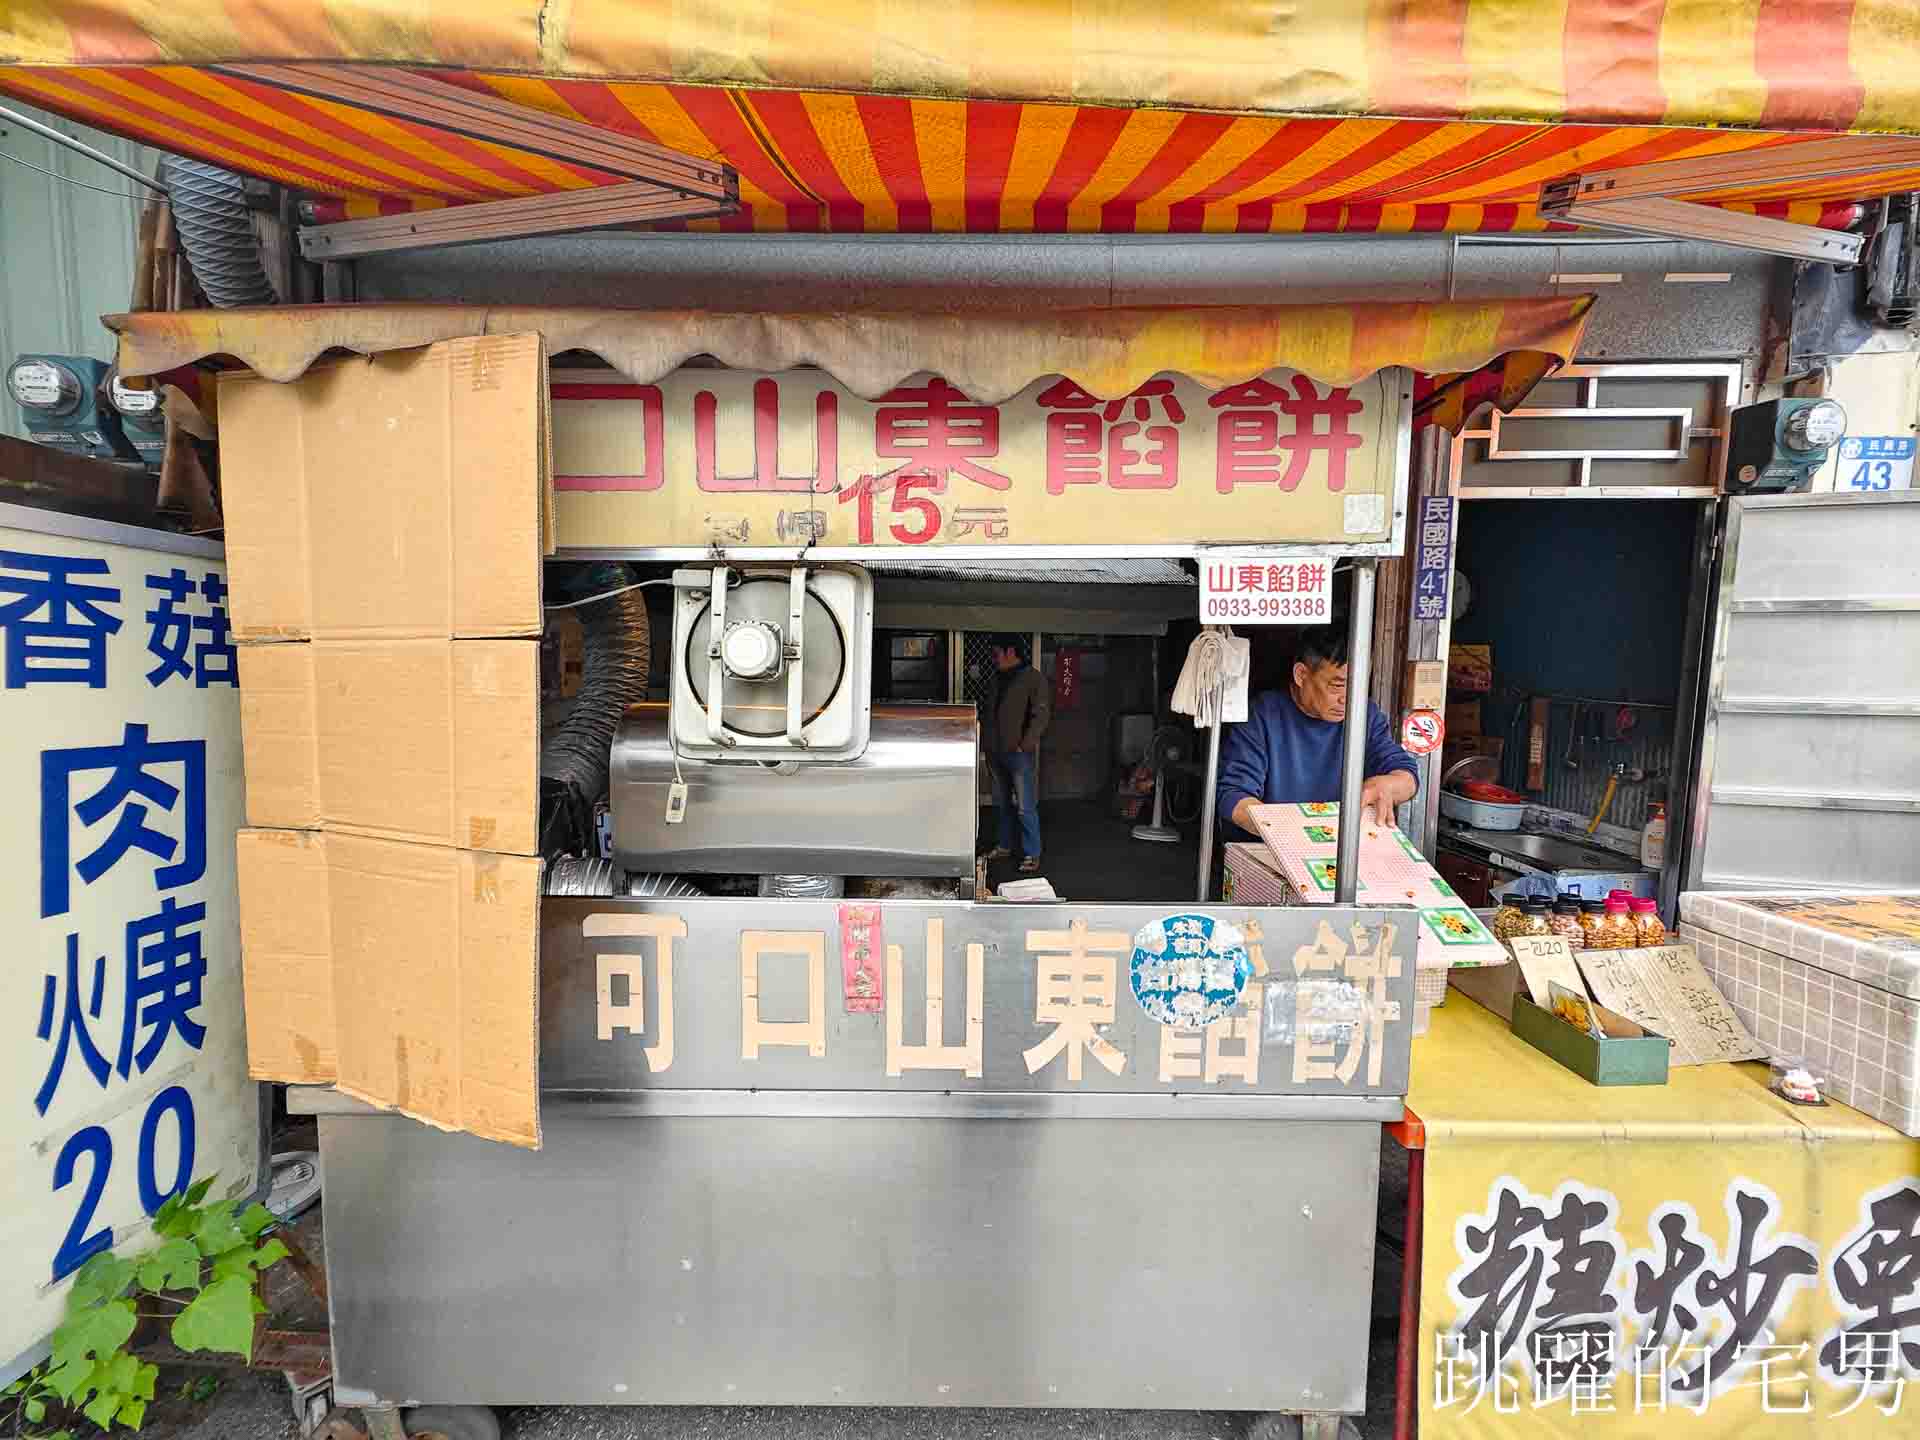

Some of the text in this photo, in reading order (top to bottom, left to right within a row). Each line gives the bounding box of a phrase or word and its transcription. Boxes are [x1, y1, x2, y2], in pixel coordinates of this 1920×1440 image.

[1851, 461, 1893, 491] 43
[1208, 563, 1327, 594] 山東餡餅
[1416, 499, 1450, 618] 民國路41號
[0, 548, 239, 690] 香菇
[1207, 599, 1326, 618] 0933-993388
[50, 1085, 197, 1285] 20
